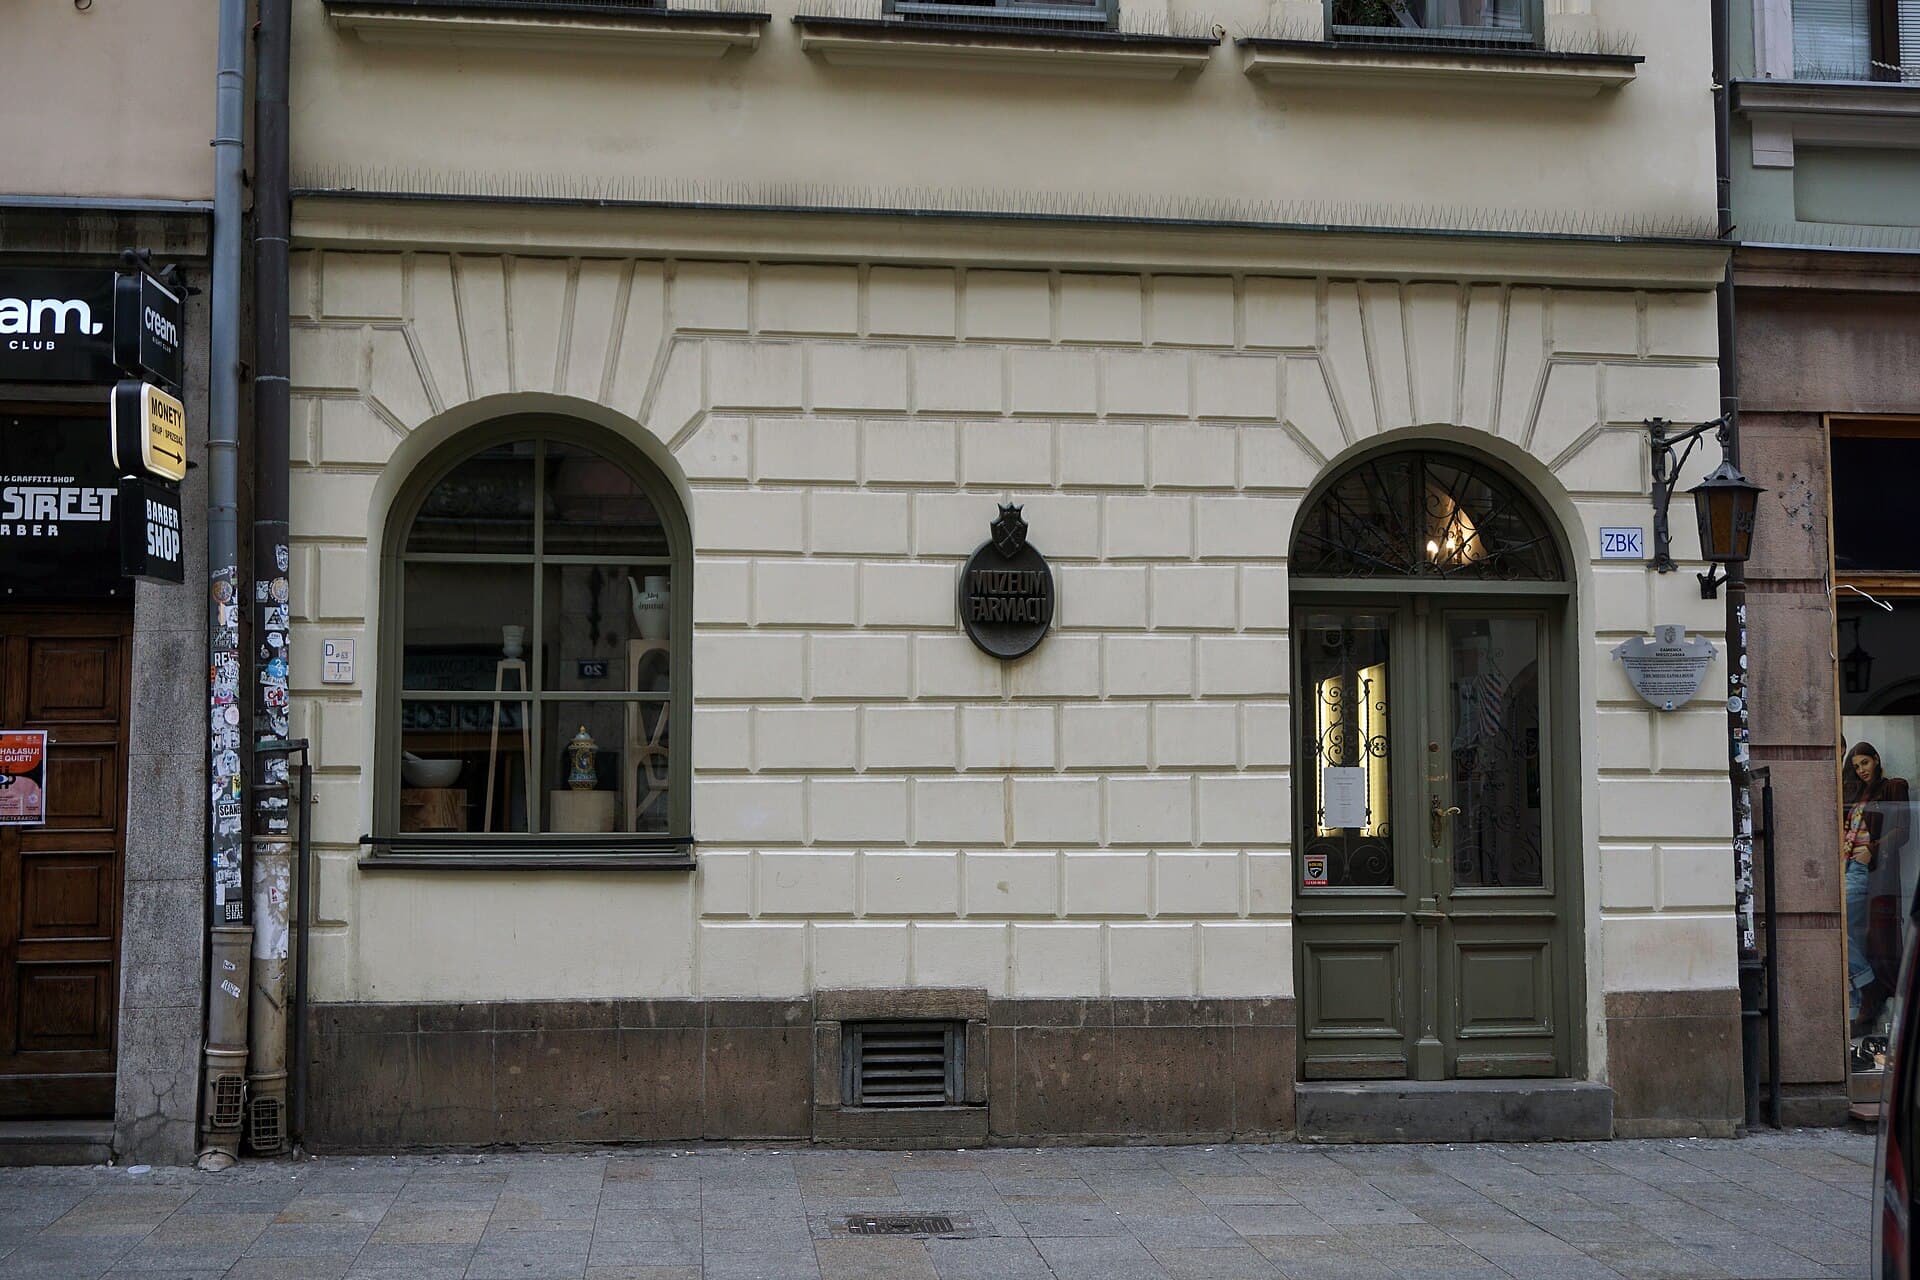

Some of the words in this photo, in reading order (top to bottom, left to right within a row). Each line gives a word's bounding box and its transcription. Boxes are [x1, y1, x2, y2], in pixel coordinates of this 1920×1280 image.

[9, 340, 55, 350] CLUB
[151, 396, 182, 429] MONETY
[151, 422, 163, 435] SKUP
[11, 475, 52, 483] GRAFFITI
[52, 476, 75, 484] SHOP
[2, 486, 118, 521] STREET
[146, 498, 179, 529] BARBER
[0, 524, 59, 536] RBER
[147, 521, 180, 562] SHOP
[1604, 533, 1639, 552] ZBK
[969, 570, 1047, 595] MUZEUM
[325, 643, 335, 657] D
